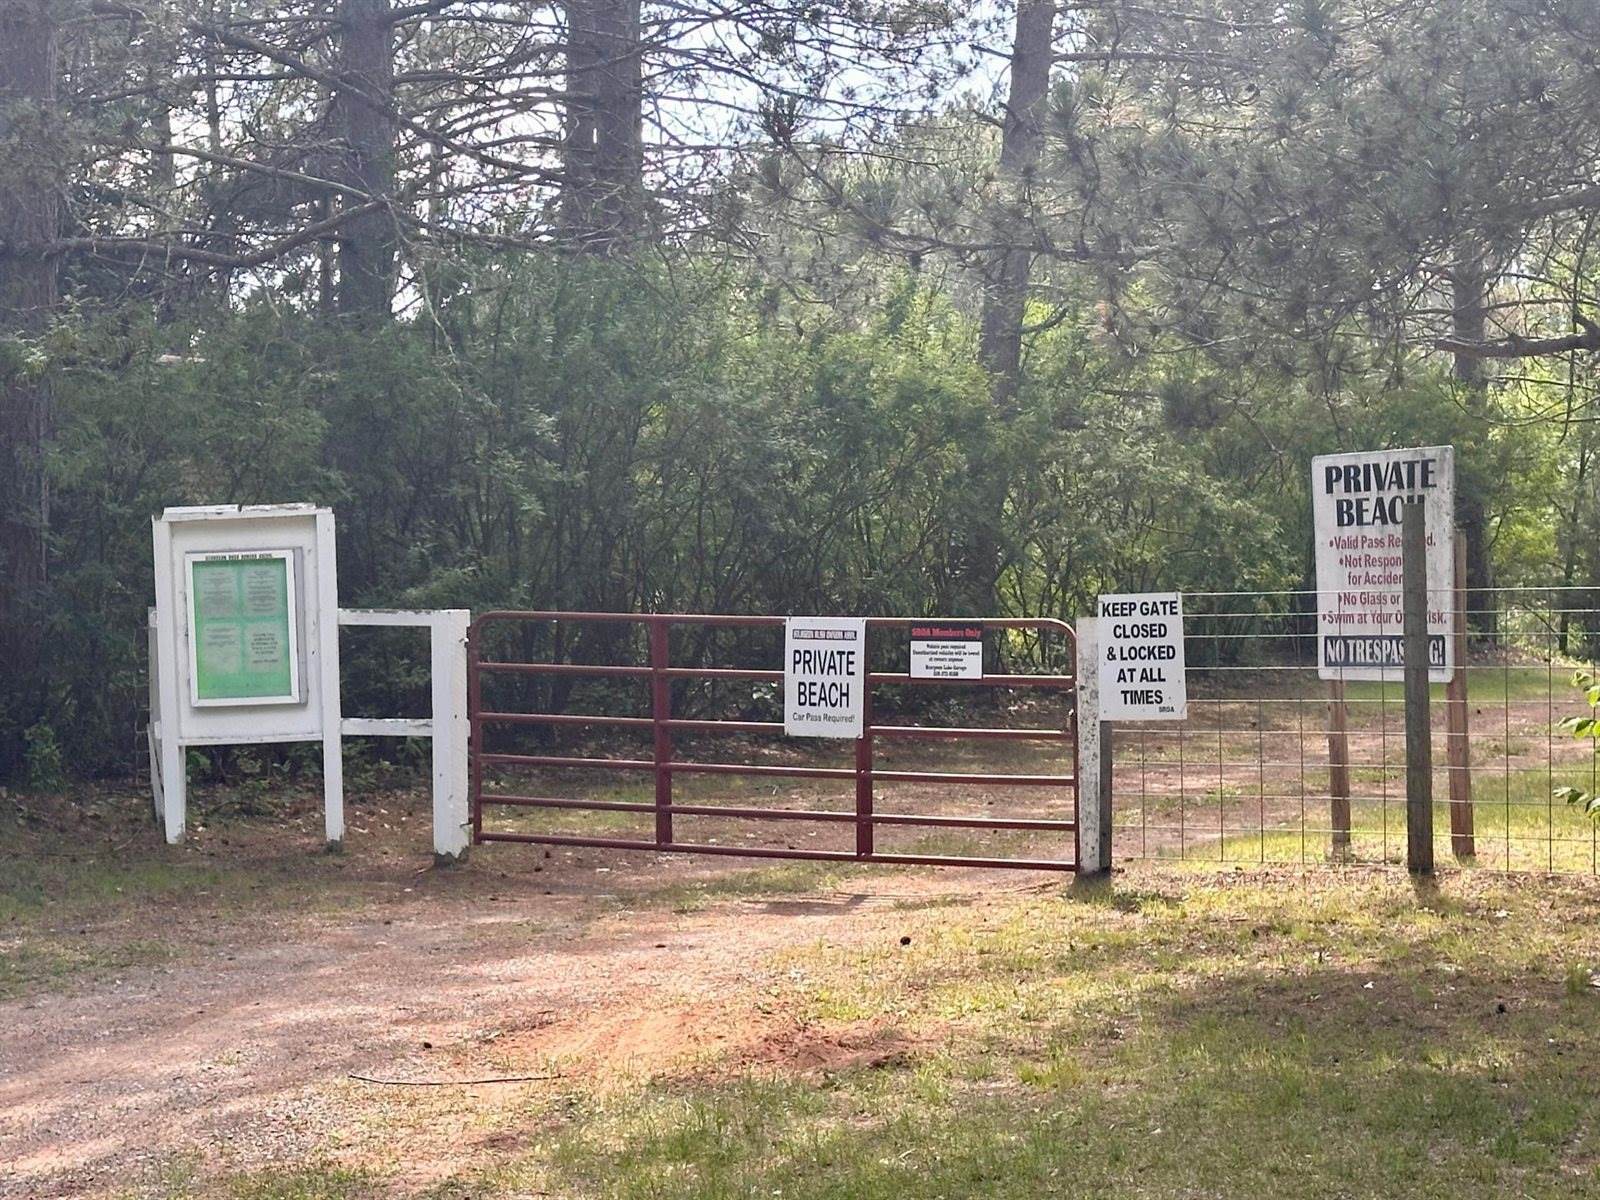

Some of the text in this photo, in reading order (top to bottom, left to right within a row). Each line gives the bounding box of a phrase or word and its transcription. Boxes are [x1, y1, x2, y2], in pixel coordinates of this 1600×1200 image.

[1325, 459, 1437, 494] PRIVATE
[1334, 535, 1359, 550] Valid
[1361, 535, 1386, 549] Pass
[1344, 553, 1403, 573] Not Respon
[1348, 571, 1362, 586] for
[1343, 591, 1401, 606] No Glass or
[1102, 601, 1178, 617] KEEP GATE
[1327, 610, 1355, 625] Swim
[1357, 611, 1368, 624] at
[1371, 610, 1393, 624] Your
[1427, 608, 1447, 624] isk.
[1113, 623, 1168, 639] CLOSED
[1107, 645, 1176, 661] & LOCKED
[1326, 639, 1443, 665] NO TRESPASG!
[793, 649, 856, 676] PRIVATE
[1117, 668, 1166, 683] AT ALL
[798, 681, 850, 708] BEACH
[1121, 689, 1164, 705] TIMES
[793, 712, 805, 721] Car
[806, 712, 822, 722] Pass
